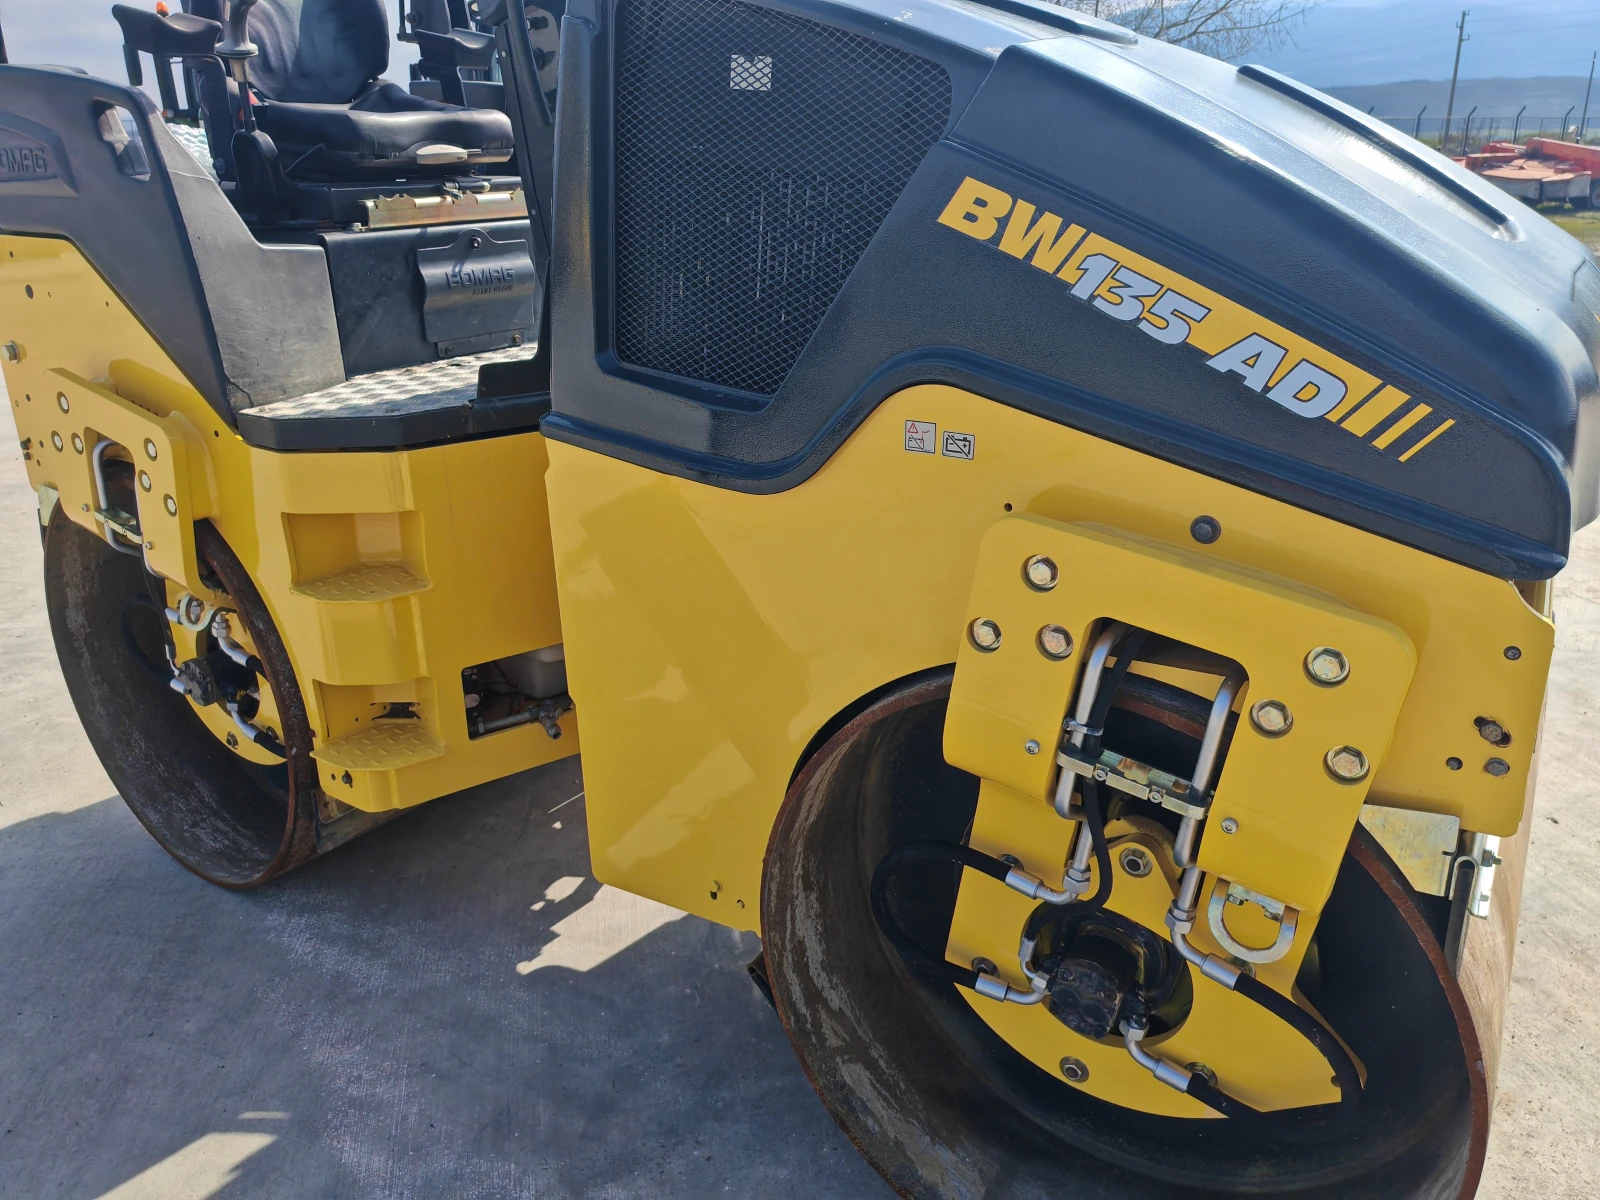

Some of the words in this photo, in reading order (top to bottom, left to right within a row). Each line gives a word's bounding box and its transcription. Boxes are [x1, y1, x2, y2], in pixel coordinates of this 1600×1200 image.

[444, 264, 515, 290] BOMAG
[1070, 252, 1212, 345] 135
[1205, 332, 1348, 419] AD
